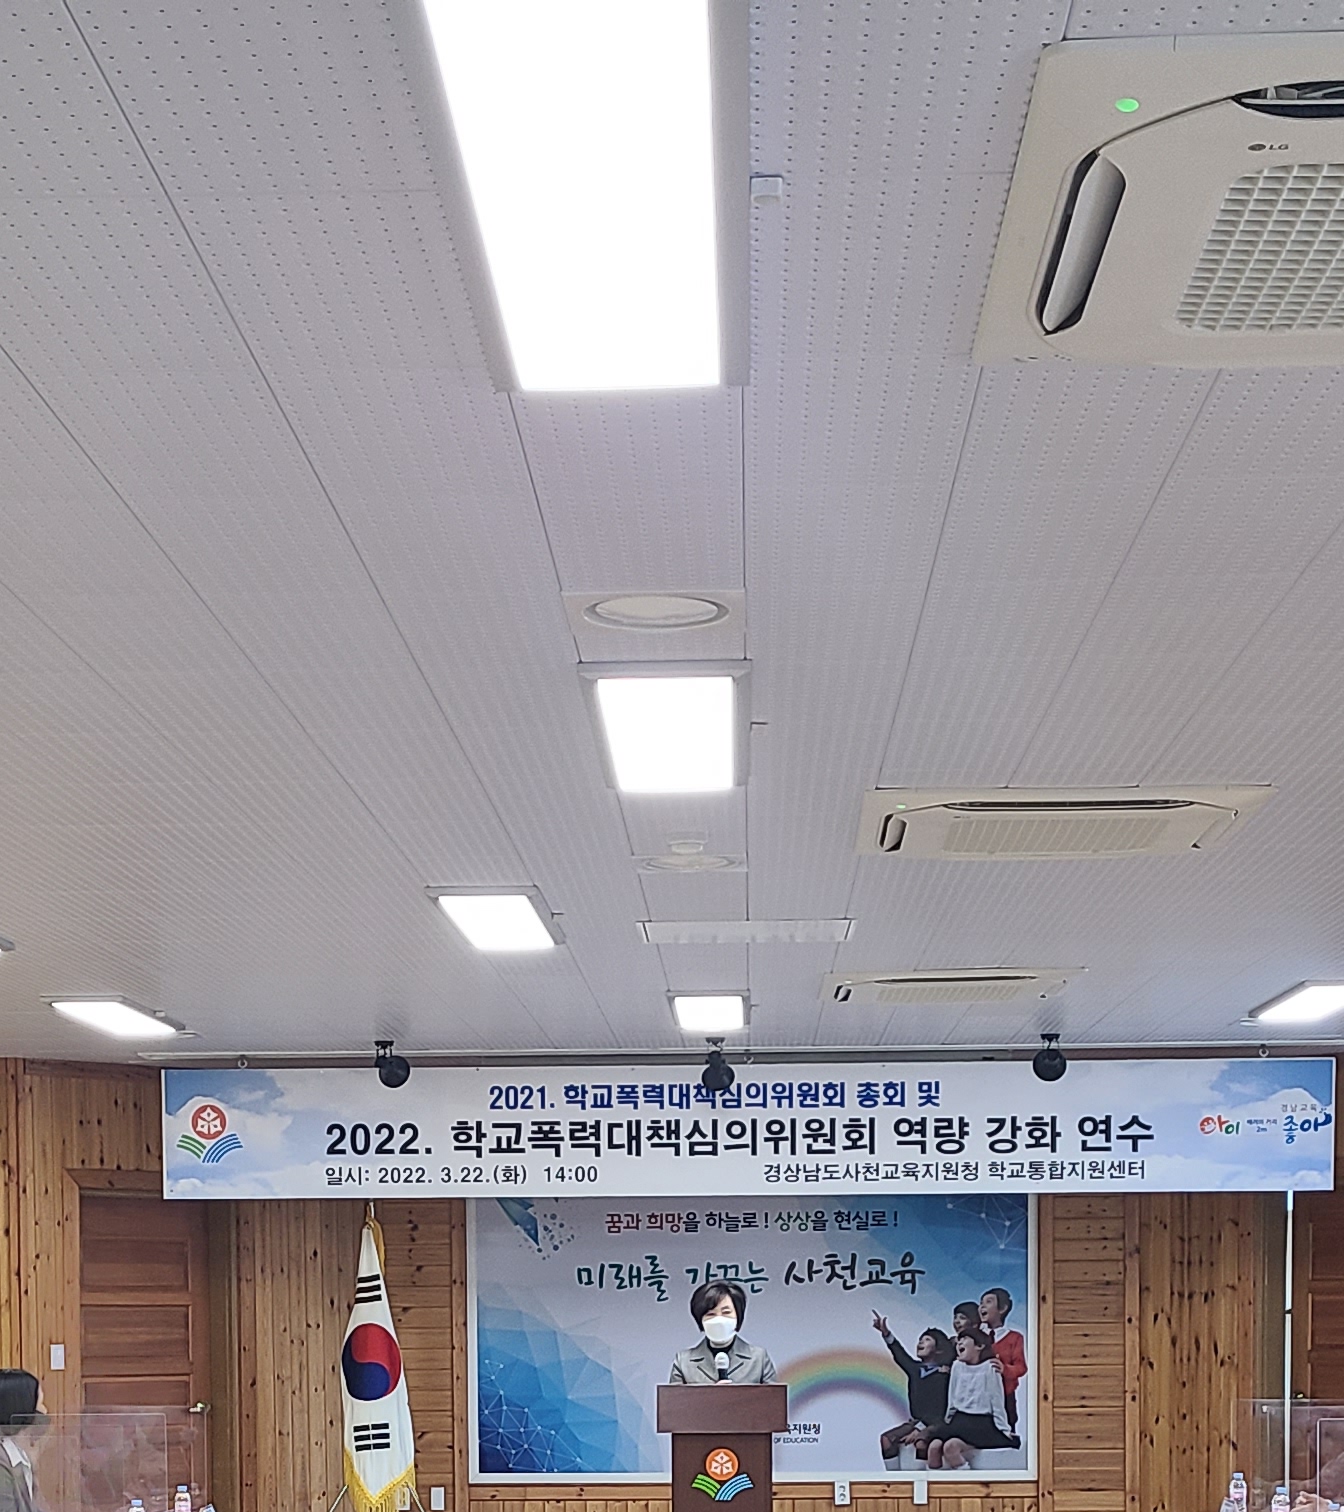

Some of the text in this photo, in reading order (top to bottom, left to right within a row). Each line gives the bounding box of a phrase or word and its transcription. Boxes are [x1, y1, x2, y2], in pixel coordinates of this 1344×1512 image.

[488, 1080, 941, 1111] 2021. 학교폭력대책심의위원회 총회 및
[325, 1112, 1156, 1159] 2022. 학교폭력대책심의위원회 역량 강화 연수
[1199, 1114, 1241, 1135] 아이
[1282, 1111, 1333, 1145] 좋아
[324, 1164, 599, 1187] 일시: 2022. 3.22.(화) 14:00
[763, 1158, 1146, 1184] 경상남도사천교육지원청 학교통합지원센터
[604, 1212, 642, 1234] 꿈과
[645, 1210, 701, 1234] 희망을
[773, 1209, 829, 1233] 상상을
[575, 1254, 670, 1302] 미래를
[783, 1250, 926, 1296] 사천교육
[773, 1436, 819, 1445] OF EDUCATION
